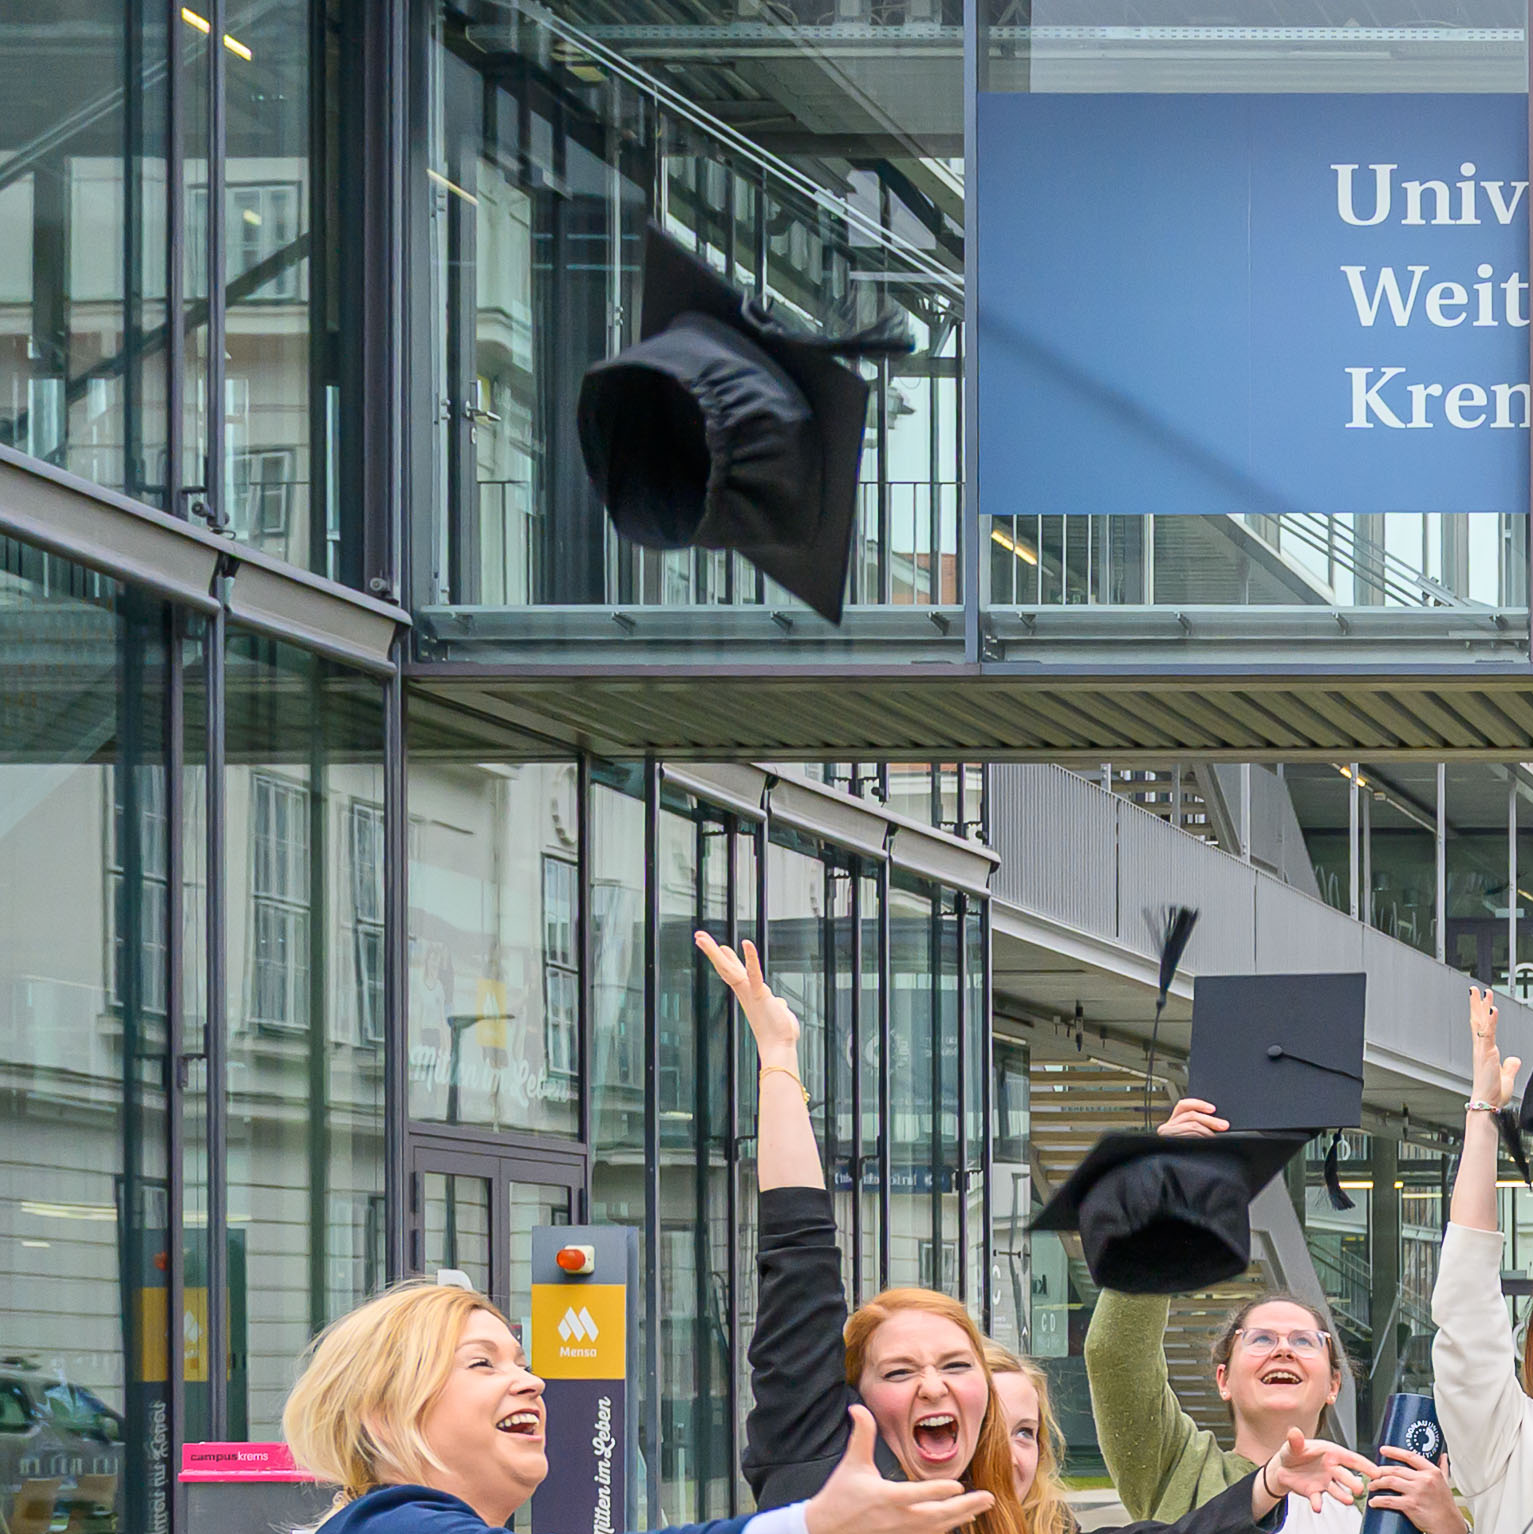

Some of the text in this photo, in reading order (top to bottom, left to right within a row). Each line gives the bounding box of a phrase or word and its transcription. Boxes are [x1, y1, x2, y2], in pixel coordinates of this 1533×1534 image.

[559, 1346, 597, 1358] Mensa
[591, 1396, 616, 1459] Leben
[190, 1451, 269, 1462] campuskrems
[593, 1458, 613, 1487] im
